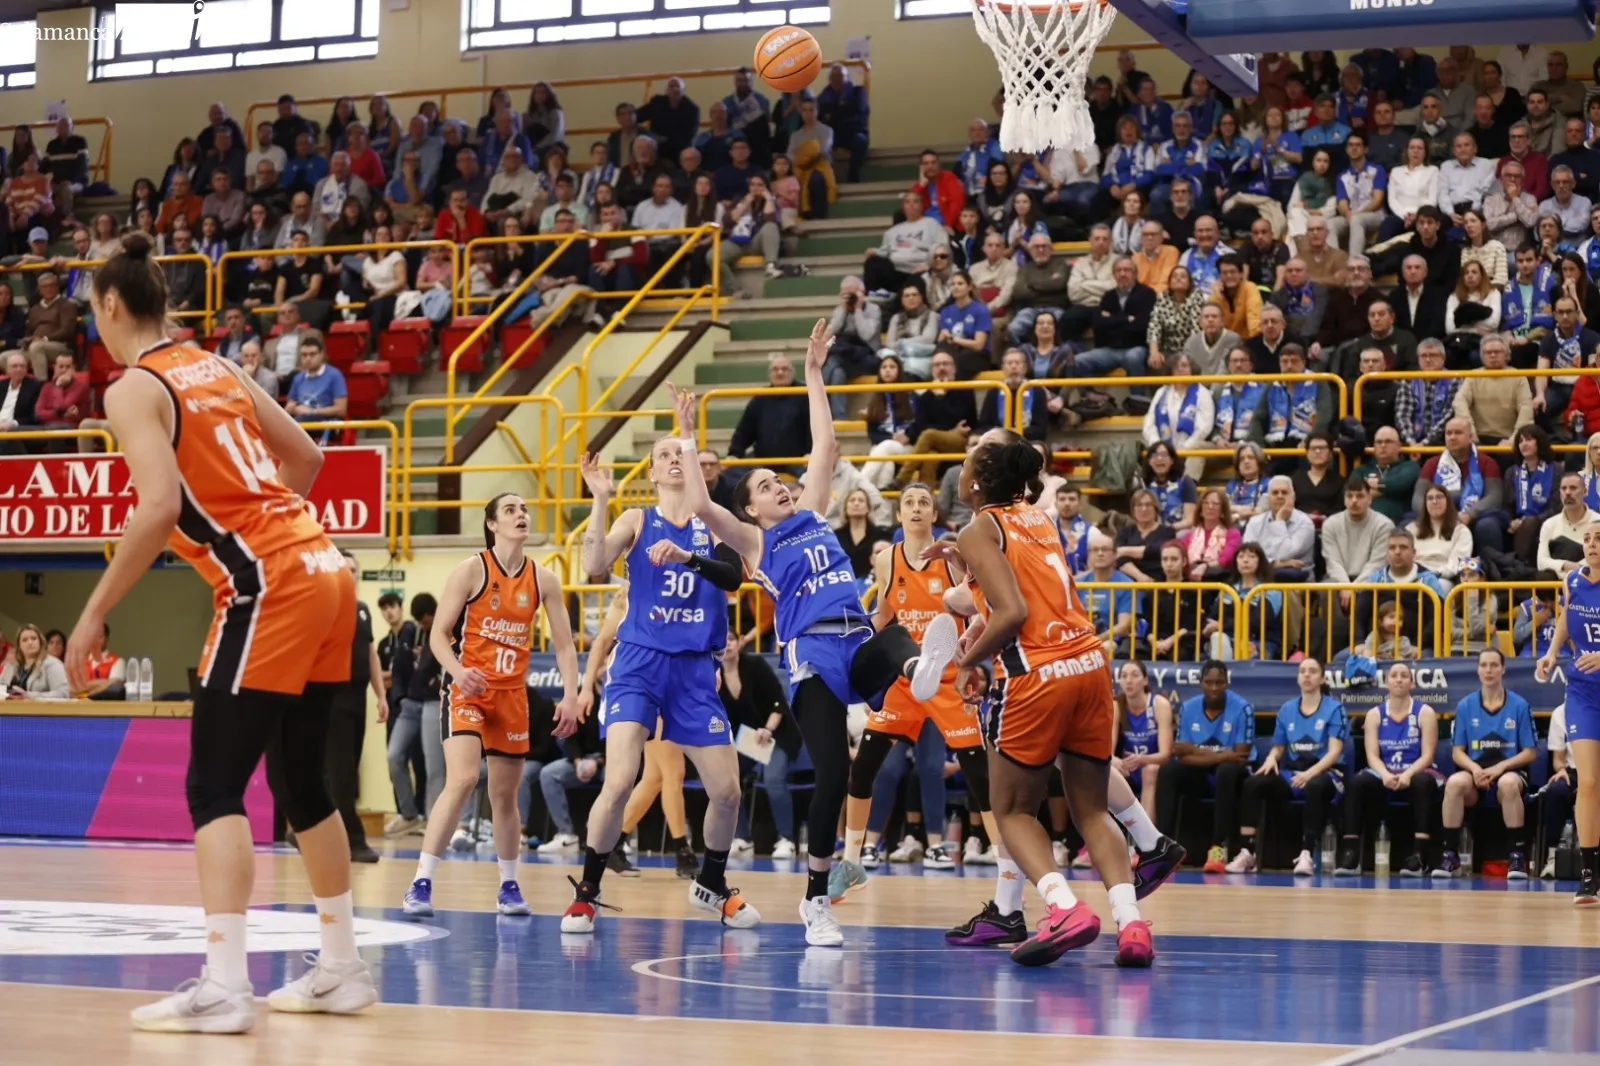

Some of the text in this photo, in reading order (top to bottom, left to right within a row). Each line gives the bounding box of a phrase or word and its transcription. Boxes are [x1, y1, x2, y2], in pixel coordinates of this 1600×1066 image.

[214, 416, 279, 493] 14
[44, 505, 91, 535] DE
[803, 544, 830, 574] 10
[661, 570, 694, 599] 30
[1045, 553, 1073, 610] 1
[495, 647, 518, 675] 10
[1153, 668, 1168, 688] Y
[1341, 693, 1382, 704] Patrimonio
